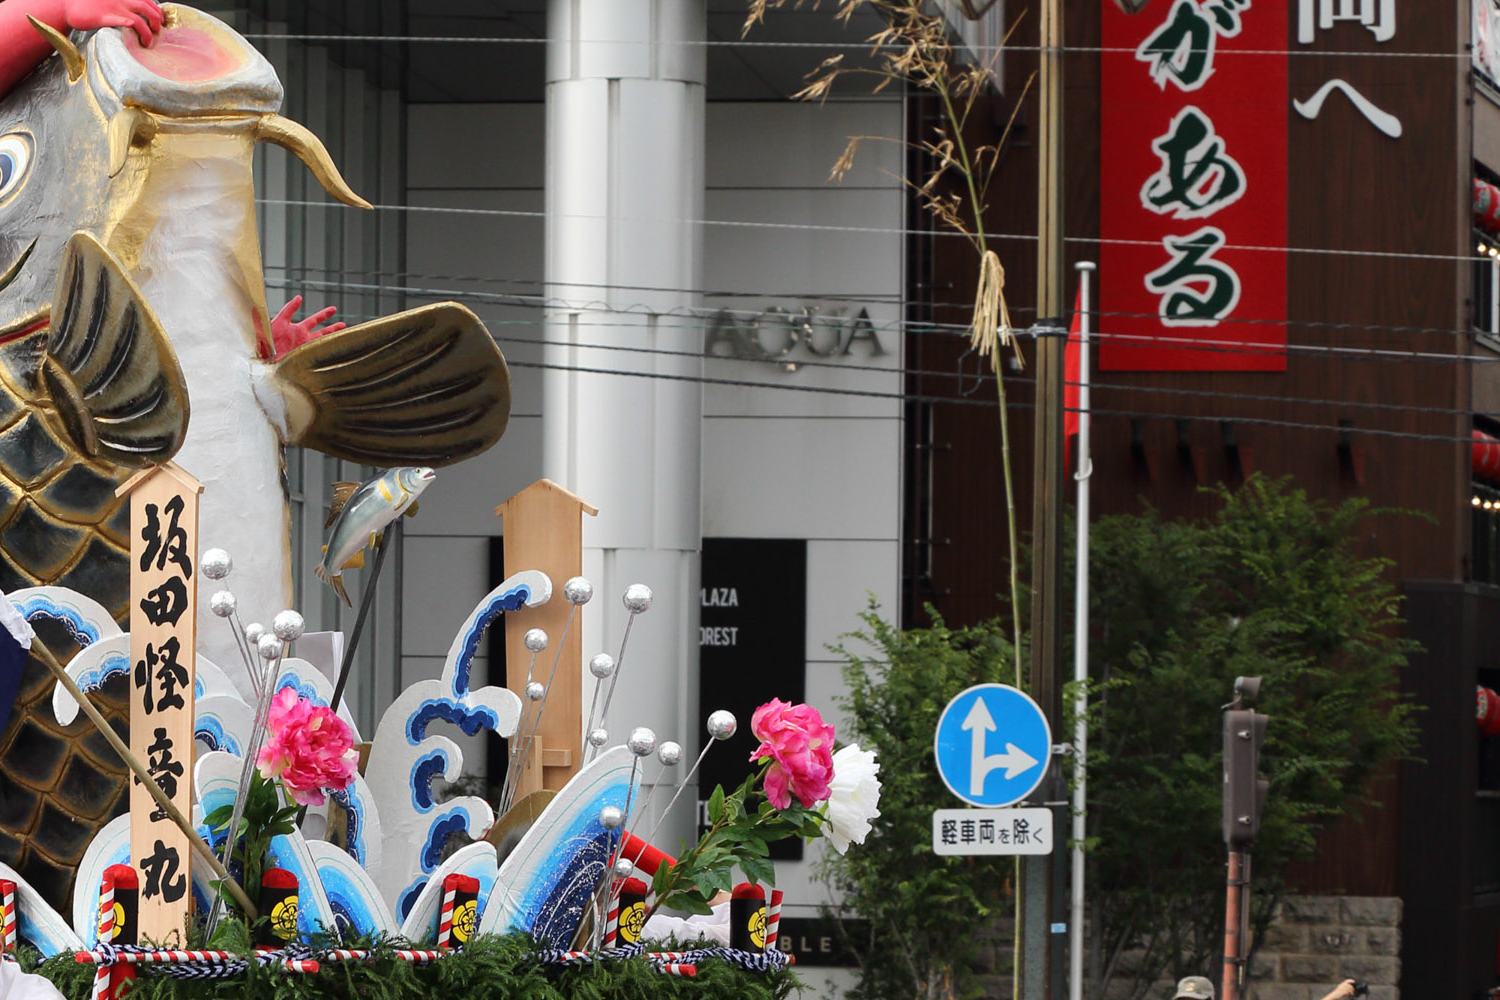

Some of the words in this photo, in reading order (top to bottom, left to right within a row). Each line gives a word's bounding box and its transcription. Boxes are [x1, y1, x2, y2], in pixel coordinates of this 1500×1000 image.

[704, 306, 886, 372] AQUA
[700, 588, 739, 607] LAZA
[135, 494, 193, 903] 坂田怪童丸
[941, 818, 1043, 845] 軽車両を除く
